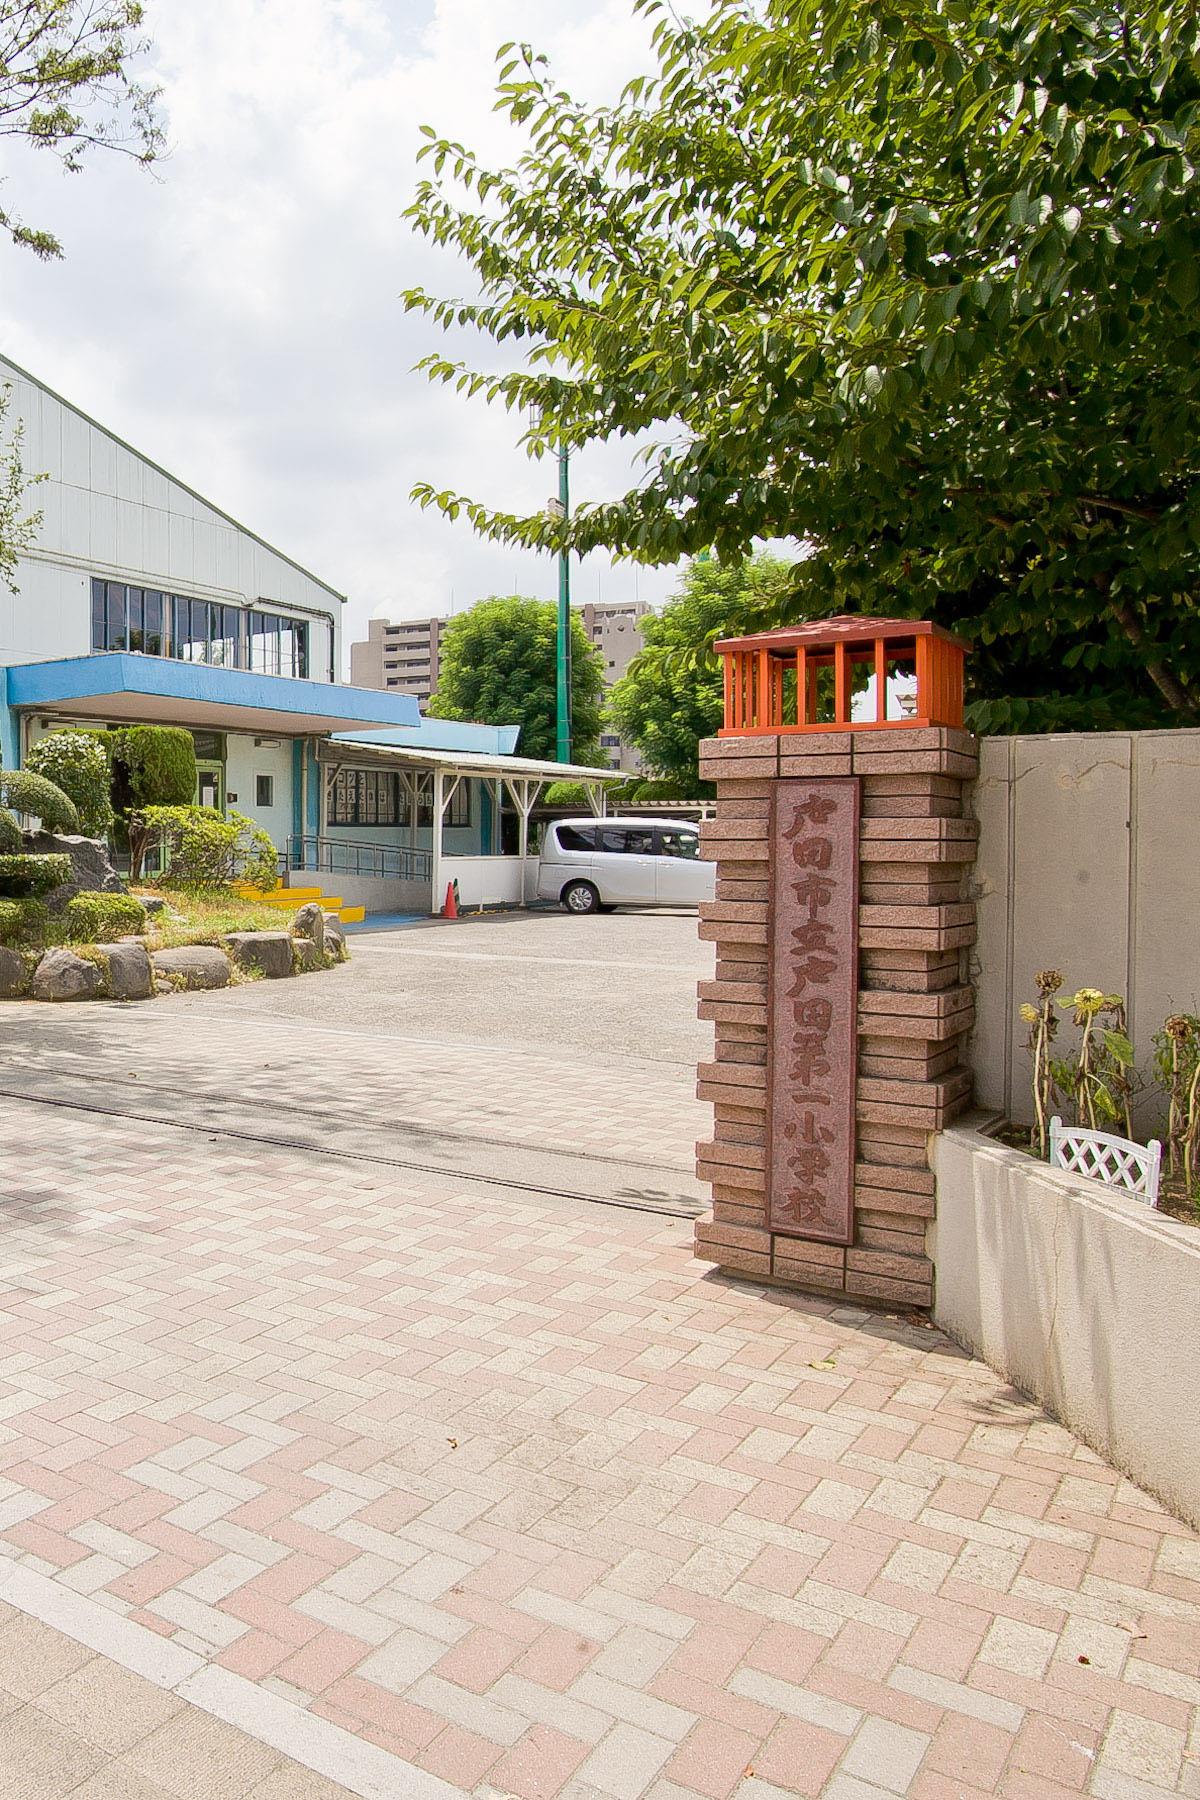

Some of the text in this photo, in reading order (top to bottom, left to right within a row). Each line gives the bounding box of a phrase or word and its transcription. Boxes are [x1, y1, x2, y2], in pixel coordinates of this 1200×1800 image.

[782, 793, 838, 1226] 戸田市立戸田第一小学校
